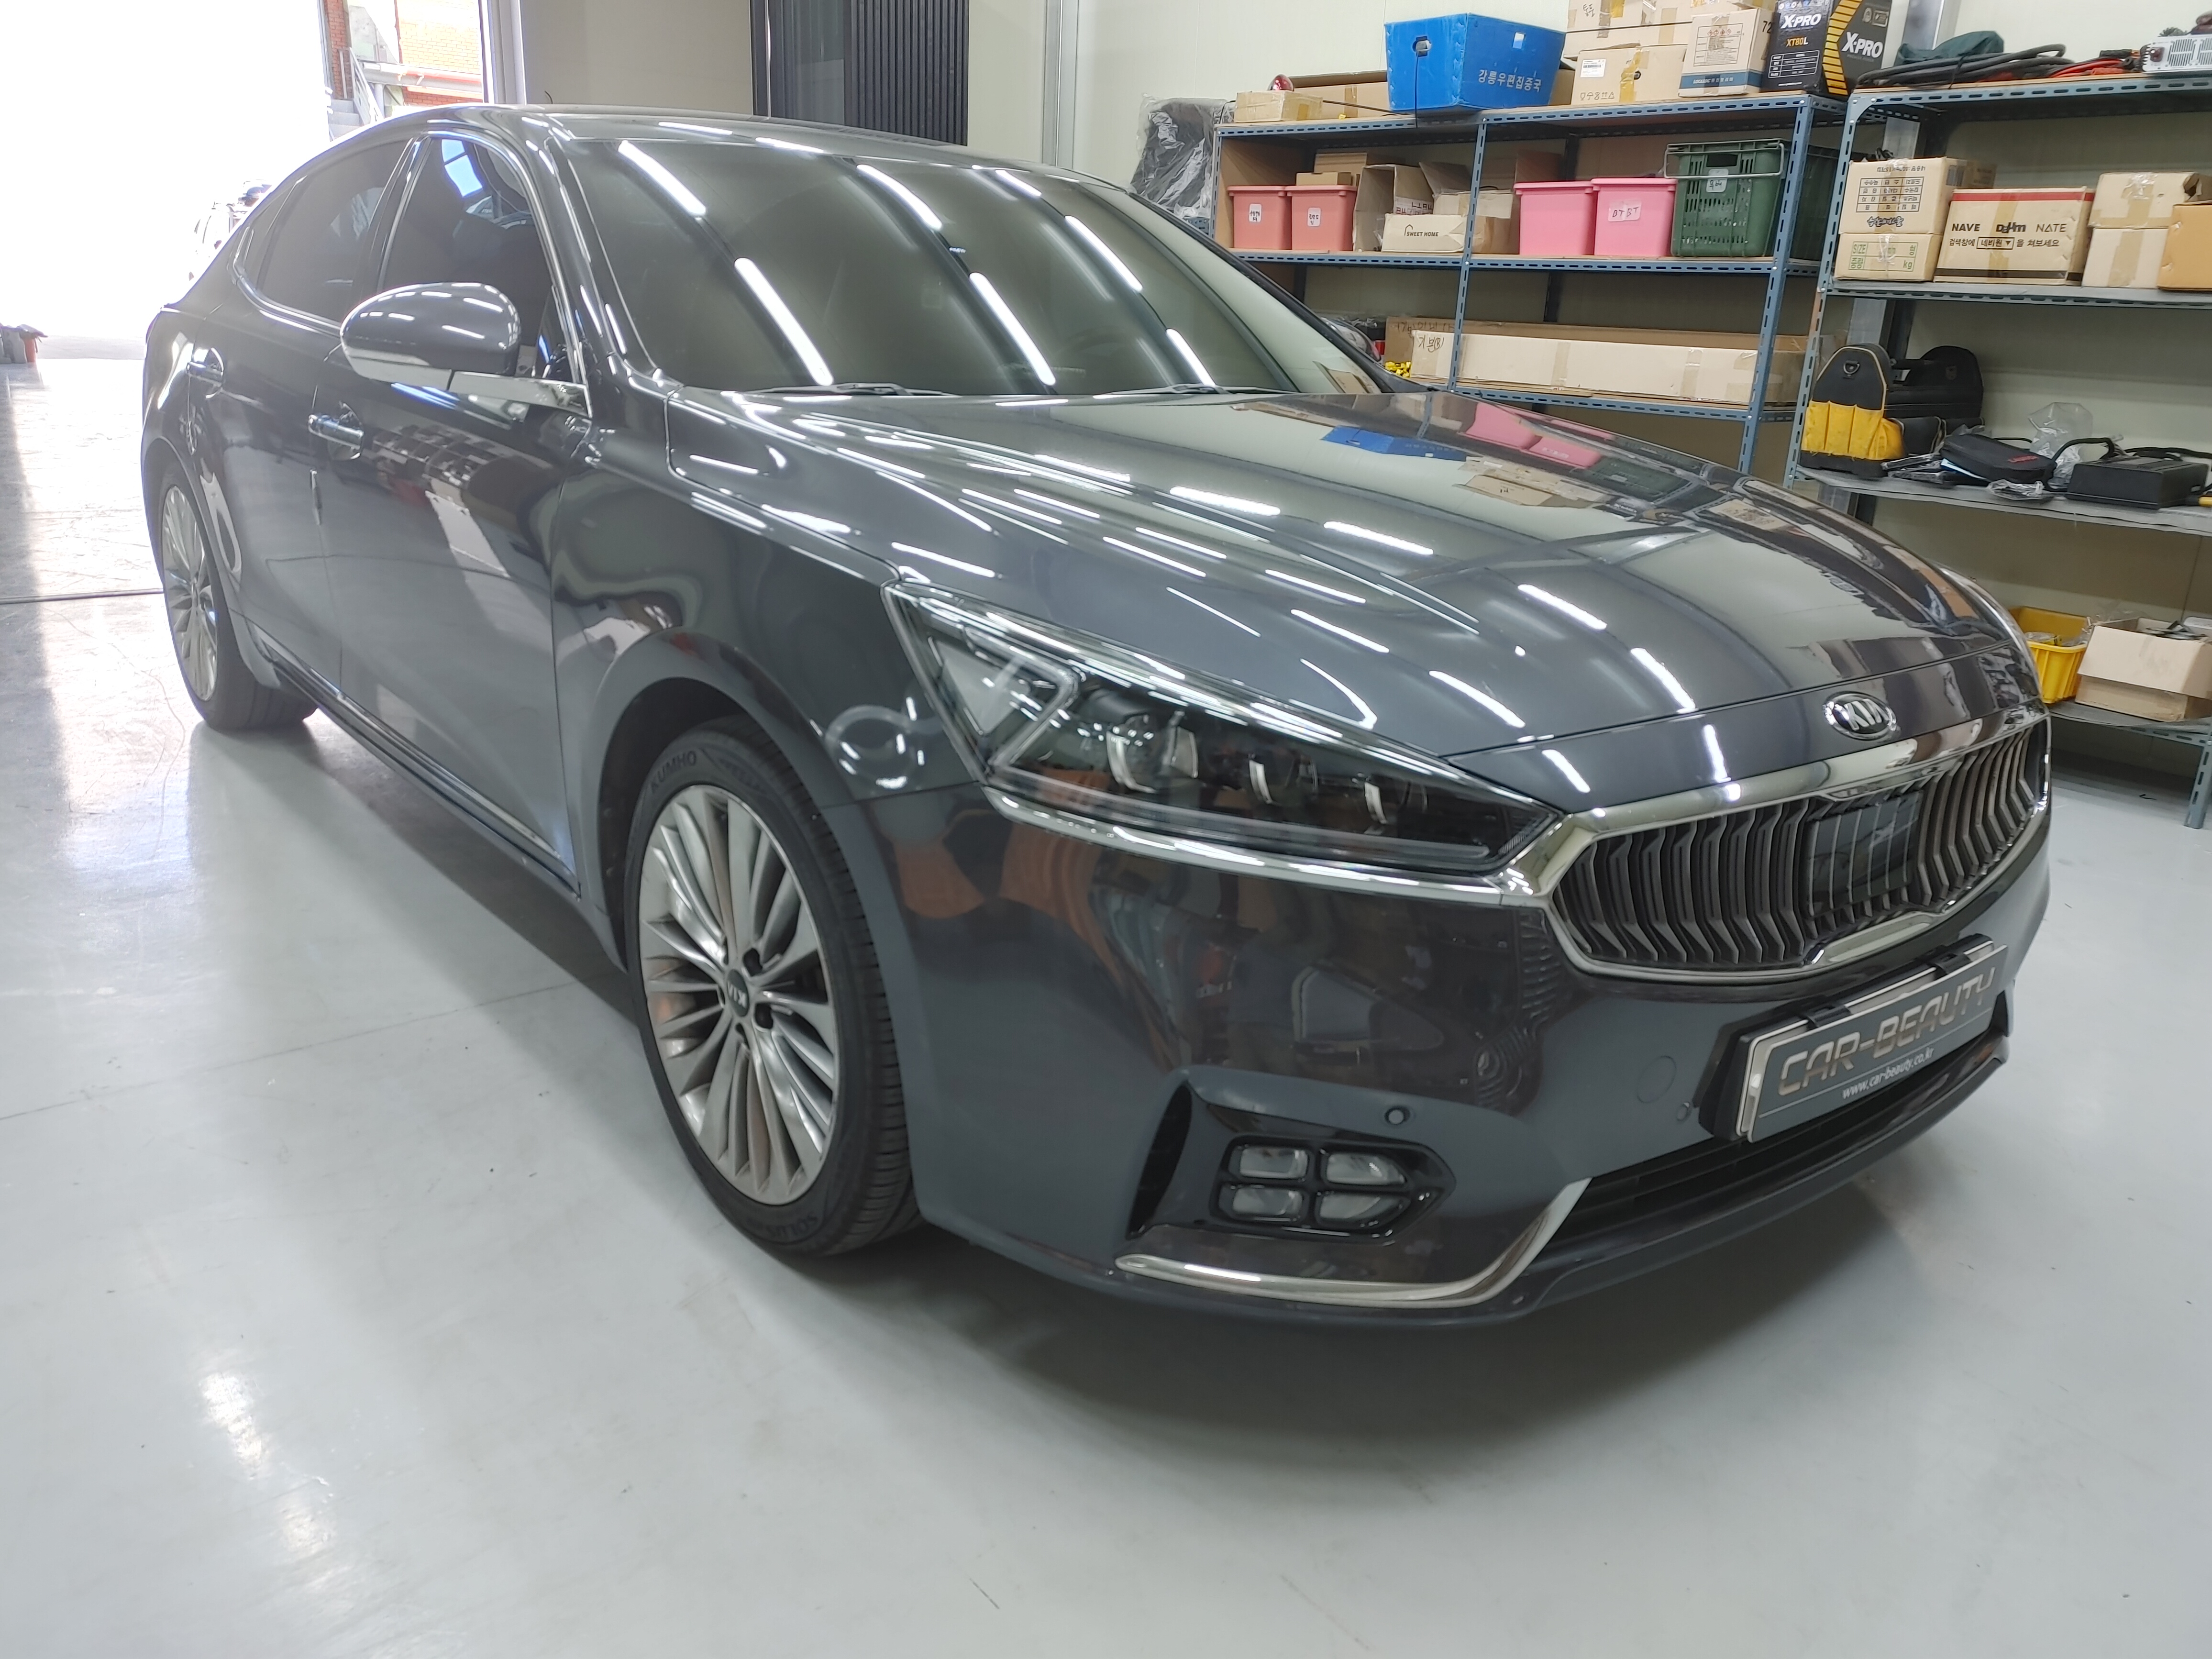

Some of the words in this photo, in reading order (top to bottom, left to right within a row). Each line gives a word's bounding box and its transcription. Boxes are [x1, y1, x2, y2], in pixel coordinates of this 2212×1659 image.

[1478, 69, 1541, 92] 강릉우편집중국
[1951, 223, 1980, 232] NAVE
[2036, 223, 2068, 232] NATE
[1853, 244, 1867, 254] SIZE
[1949, 238, 1976, 247] 검색창에
[1981, 239, 2002, 247] 네비원
[2016, 239, 2024, 247] 을
[1903, 260, 1913, 269] kg
[1835, 698, 1891, 731] KIA
[650, 750, 697, 794] KUMHO
[1778, 967, 1995, 1096] CAR-BEAUTY
[1842, 1046, 1935, 1100] www.car-beauty.co.kr
